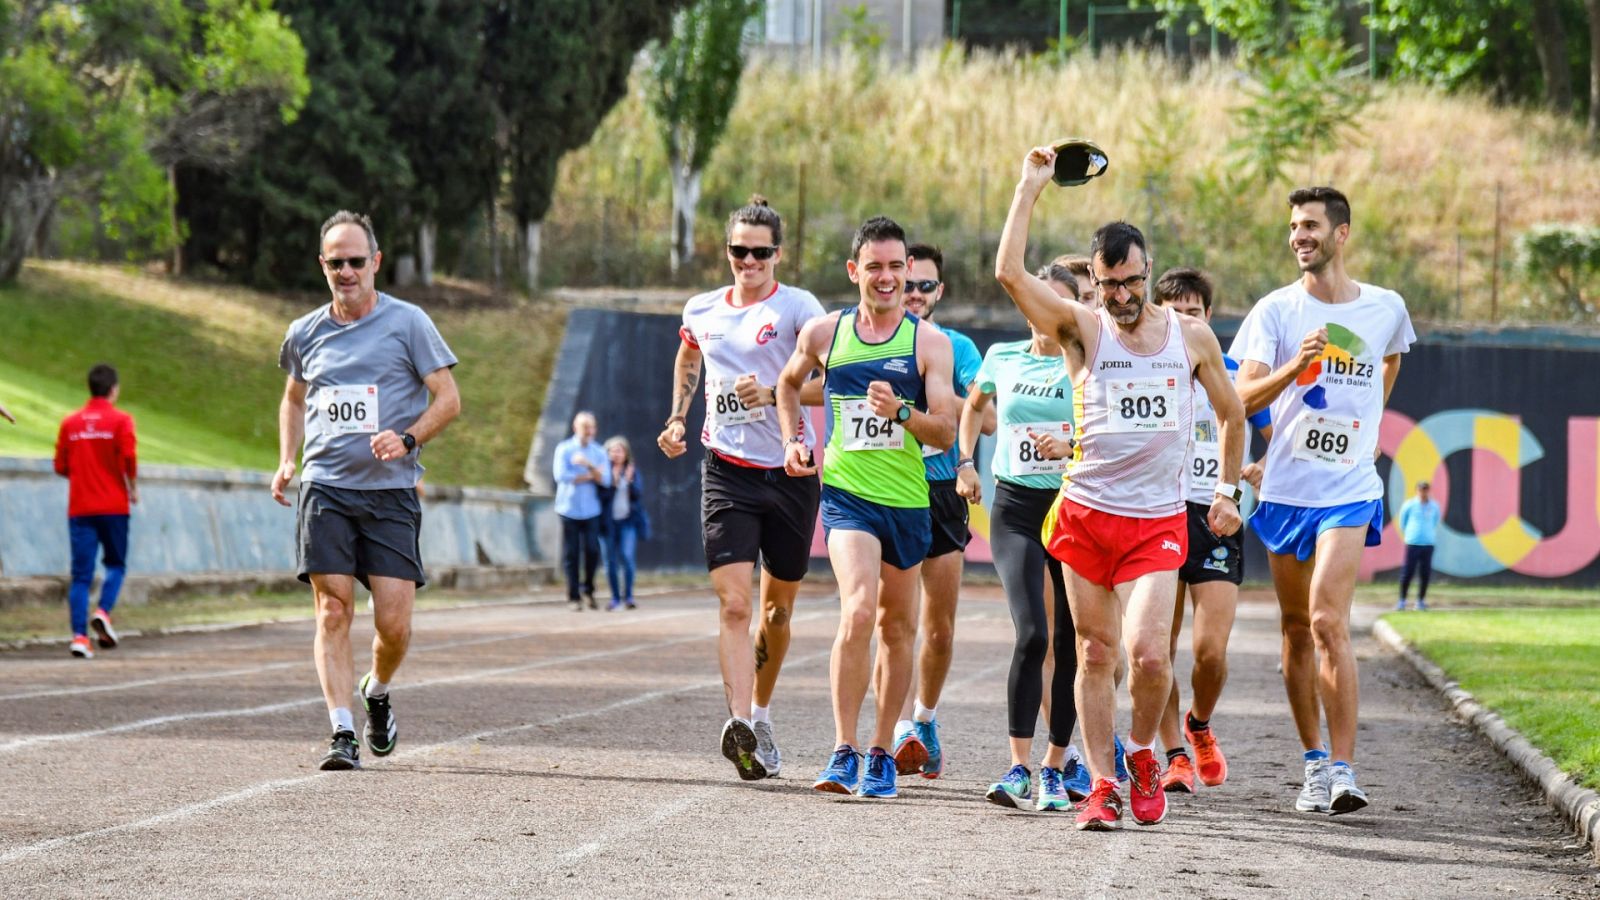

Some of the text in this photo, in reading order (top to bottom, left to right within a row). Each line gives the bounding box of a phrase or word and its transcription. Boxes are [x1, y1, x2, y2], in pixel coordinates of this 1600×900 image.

[1151, 361, 1184, 370] ESPAÑA
[1326, 356, 1374, 378] Ibiza
[1012, 382, 1065, 399] BIKILA
[1325, 376, 1343, 385] Illes
[327, 401, 367, 422] 906
[1120, 395, 1167, 419] 803
[851, 416, 894, 439] 764
[1305, 429, 1349, 455] 869
